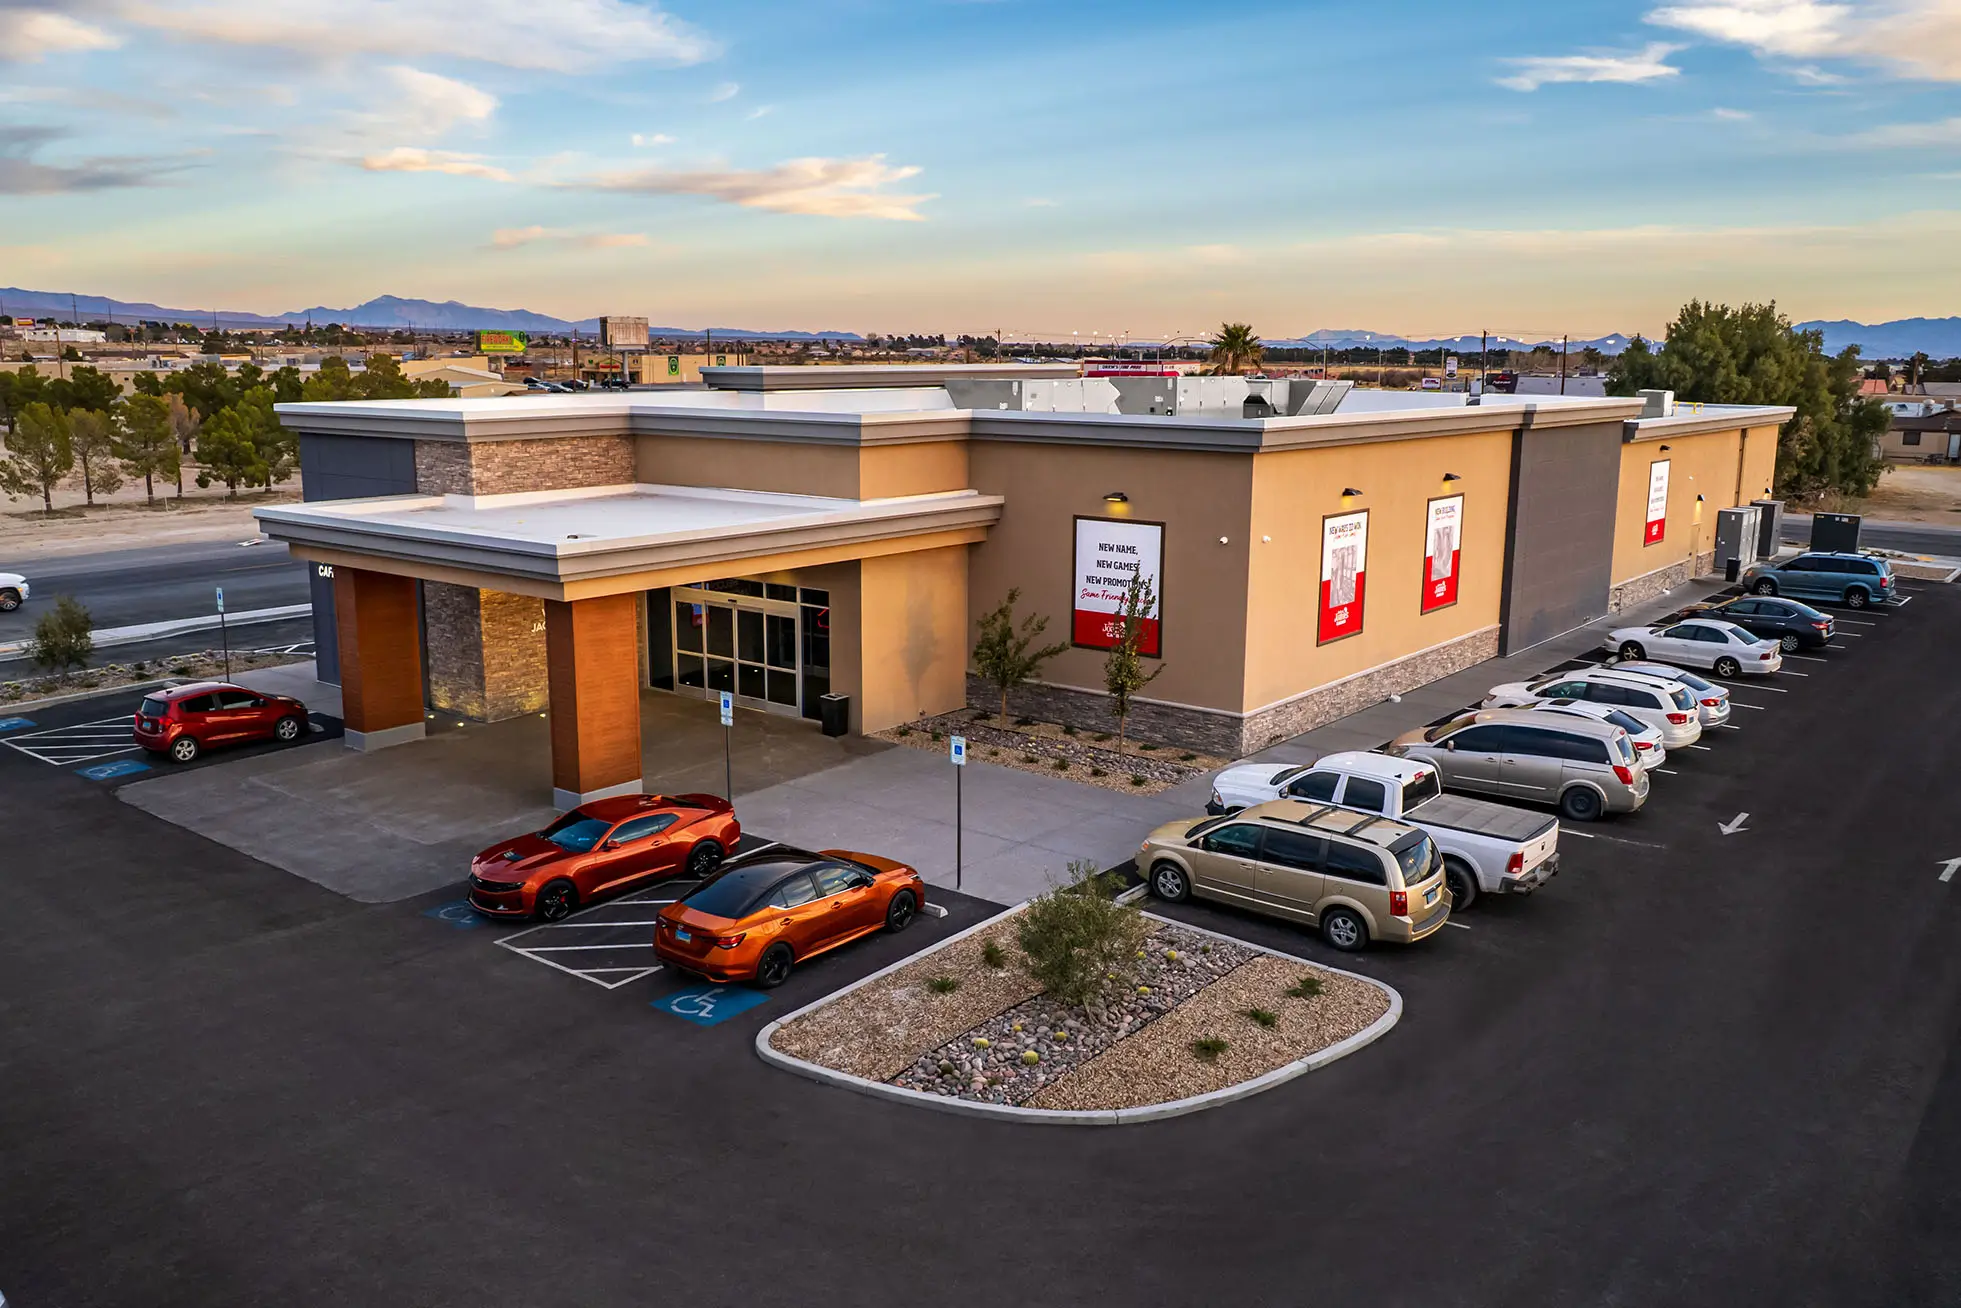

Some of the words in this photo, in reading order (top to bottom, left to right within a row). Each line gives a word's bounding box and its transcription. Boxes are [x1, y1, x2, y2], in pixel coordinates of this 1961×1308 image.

[1099, 543, 1114, 552] NEW
[1116, 544, 1138, 555] NAME,
[1097, 560, 1112, 568] NEW
[1086, 575, 1101, 584] NEW
[1103, 577, 1148, 590] PROMOTINS
[1080, 588, 1099, 599] Same
[1101, 589, 1128, 605] Frienly
